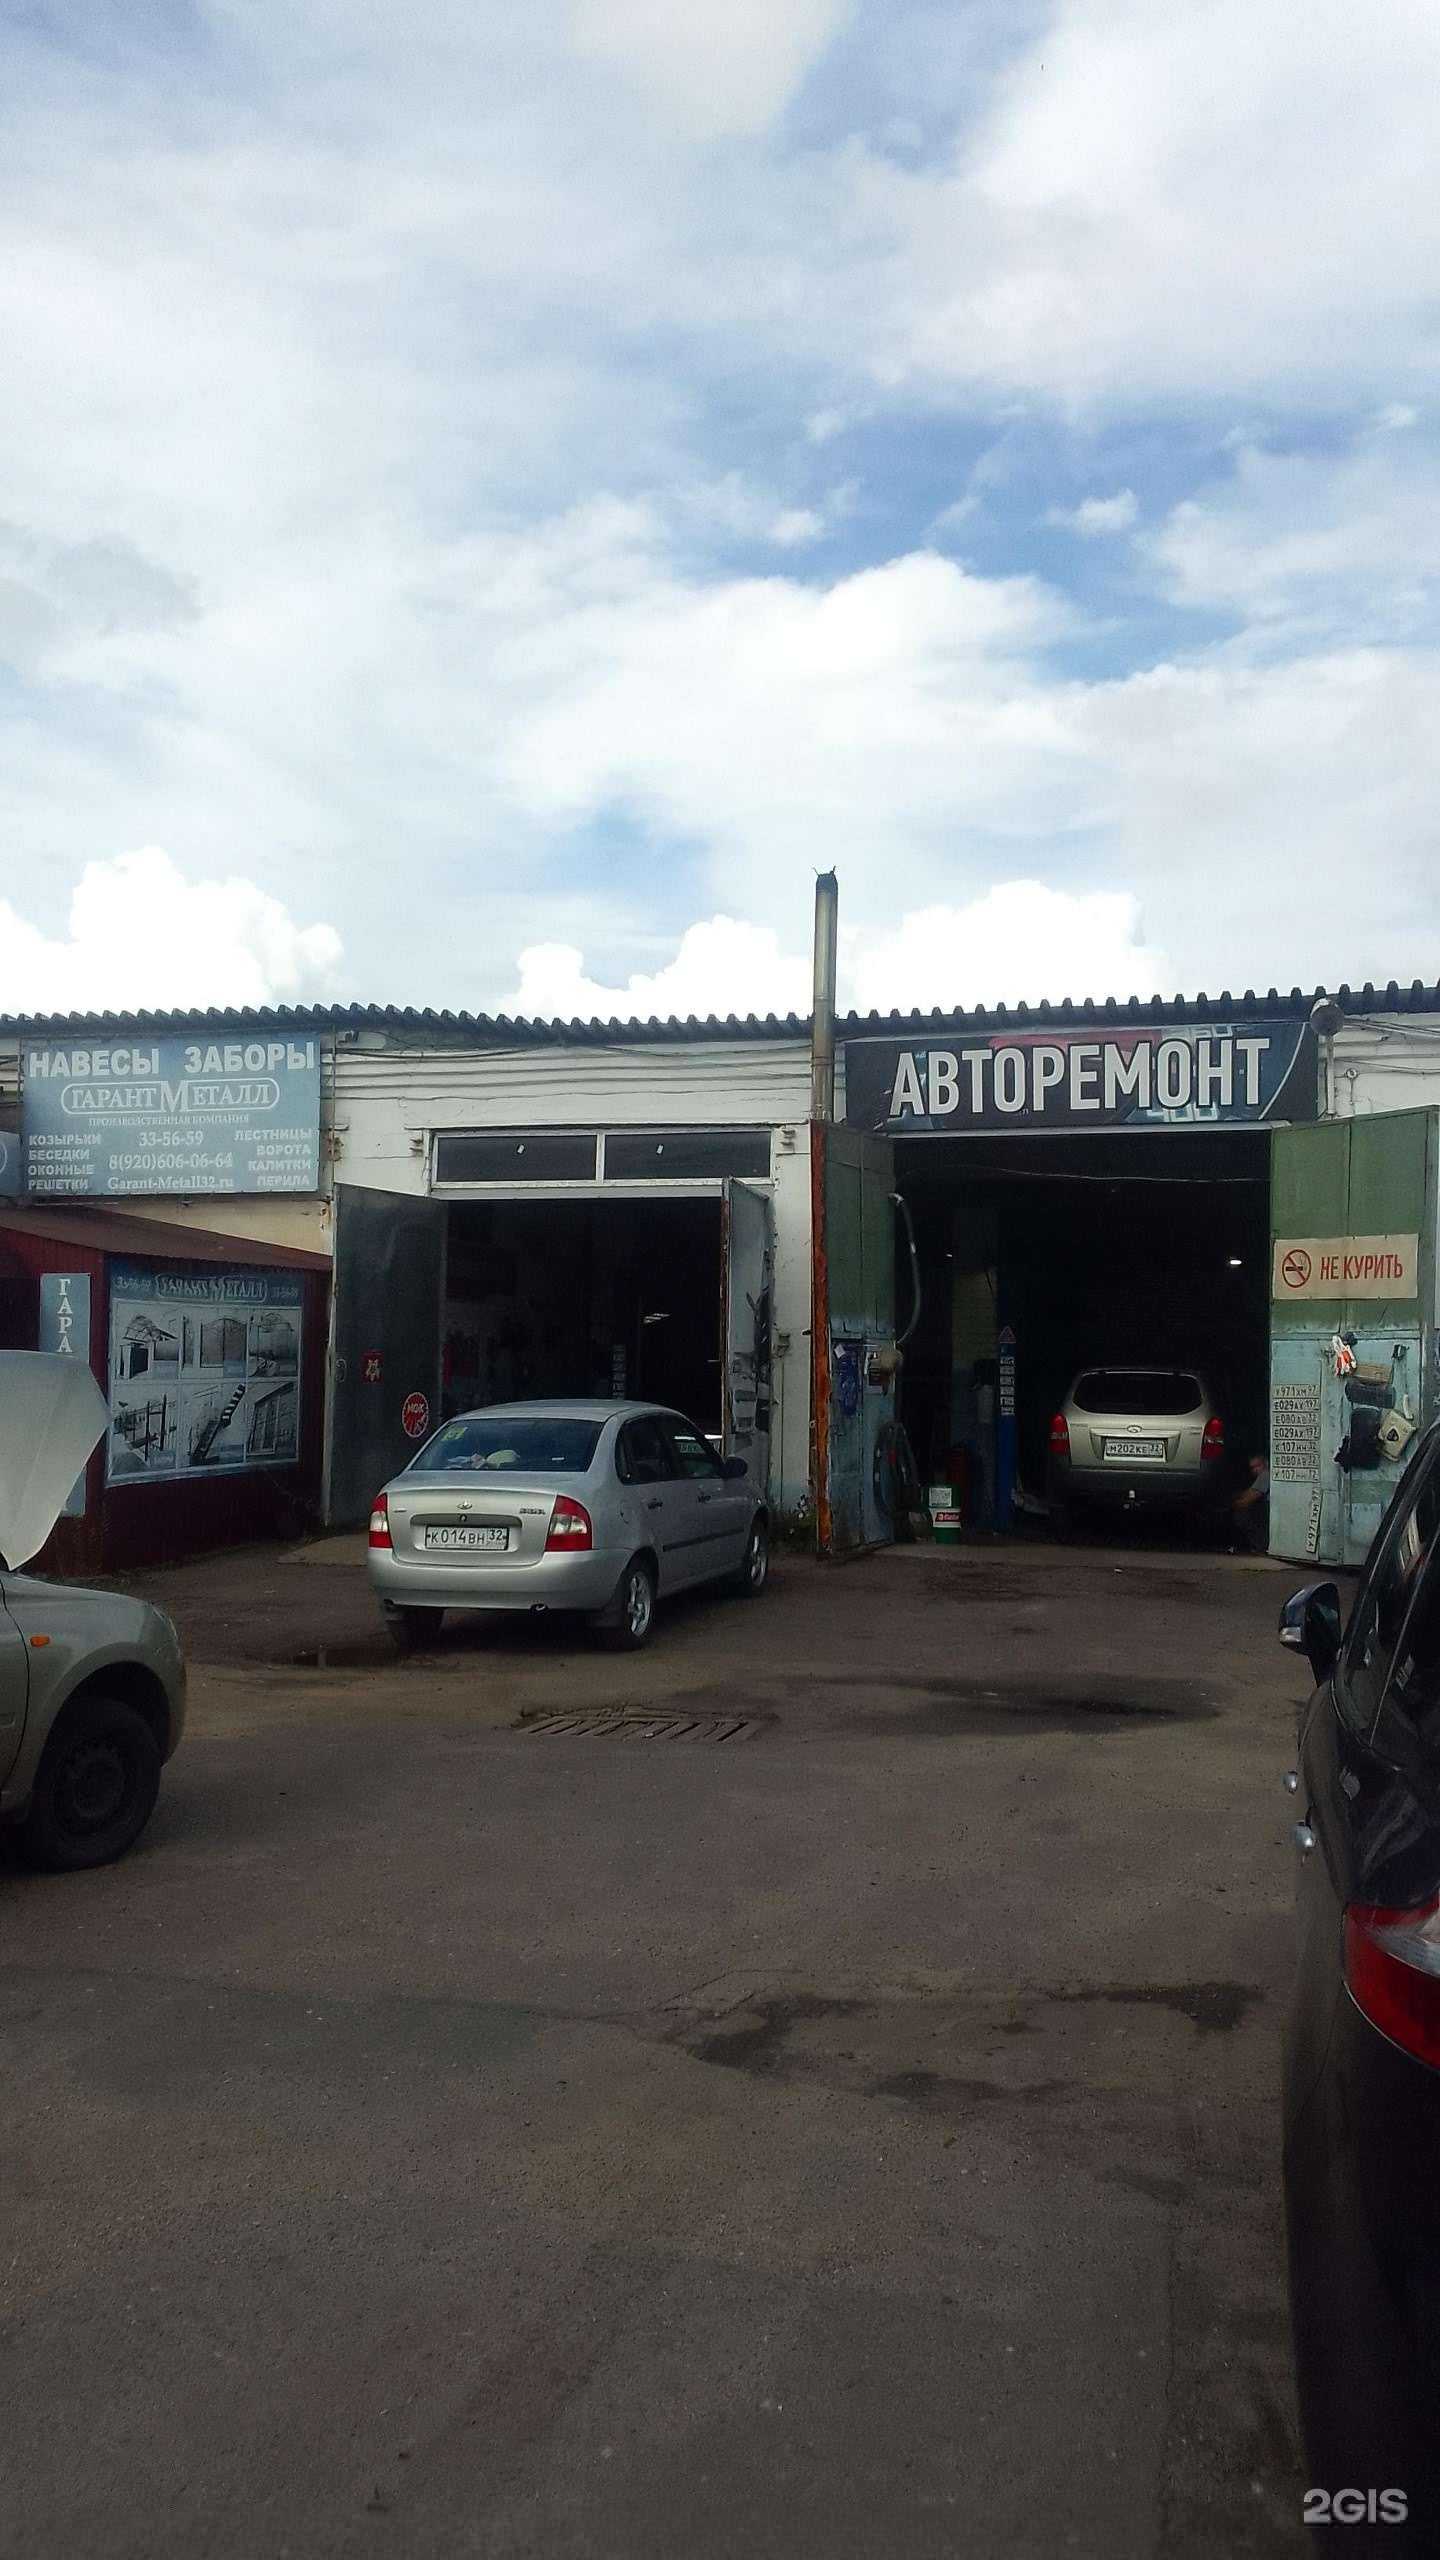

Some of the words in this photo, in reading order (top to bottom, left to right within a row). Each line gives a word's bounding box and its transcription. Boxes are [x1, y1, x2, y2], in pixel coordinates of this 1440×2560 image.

[29, 1049, 159, 1077] НАВЕСЫ
[184, 1042, 314, 1073] ЗАБОРЫ
[890, 1038, 1270, 1116] АВТОРЕМОНТ
[29, 1134, 101, 1145] КОЗЫРЬКИ
[139, 1131, 204, 1146] 33-56-59
[234, 1129, 313, 1141] ЛЕСТНИЦЫ
[29, 1149, 90, 1161] БЕСЕДКИ
[256, 1144, 312, 1155] ВОРОТА
[28, 1164, 95, 1176] ОКОННЫЕ
[248, 1159, 311, 1170] КАЛИТКИ
[28, 1179, 89, 1190] РЕШЕТКИ
[107, 1175, 234, 1190] Garant-Metall32.ru
[256, 1175, 310, 1186] ПЕРИЛА
[1320, 1256, 1339, 1280] НЕ
[1343, 1254, 1403, 1279] КУРИТЬ
